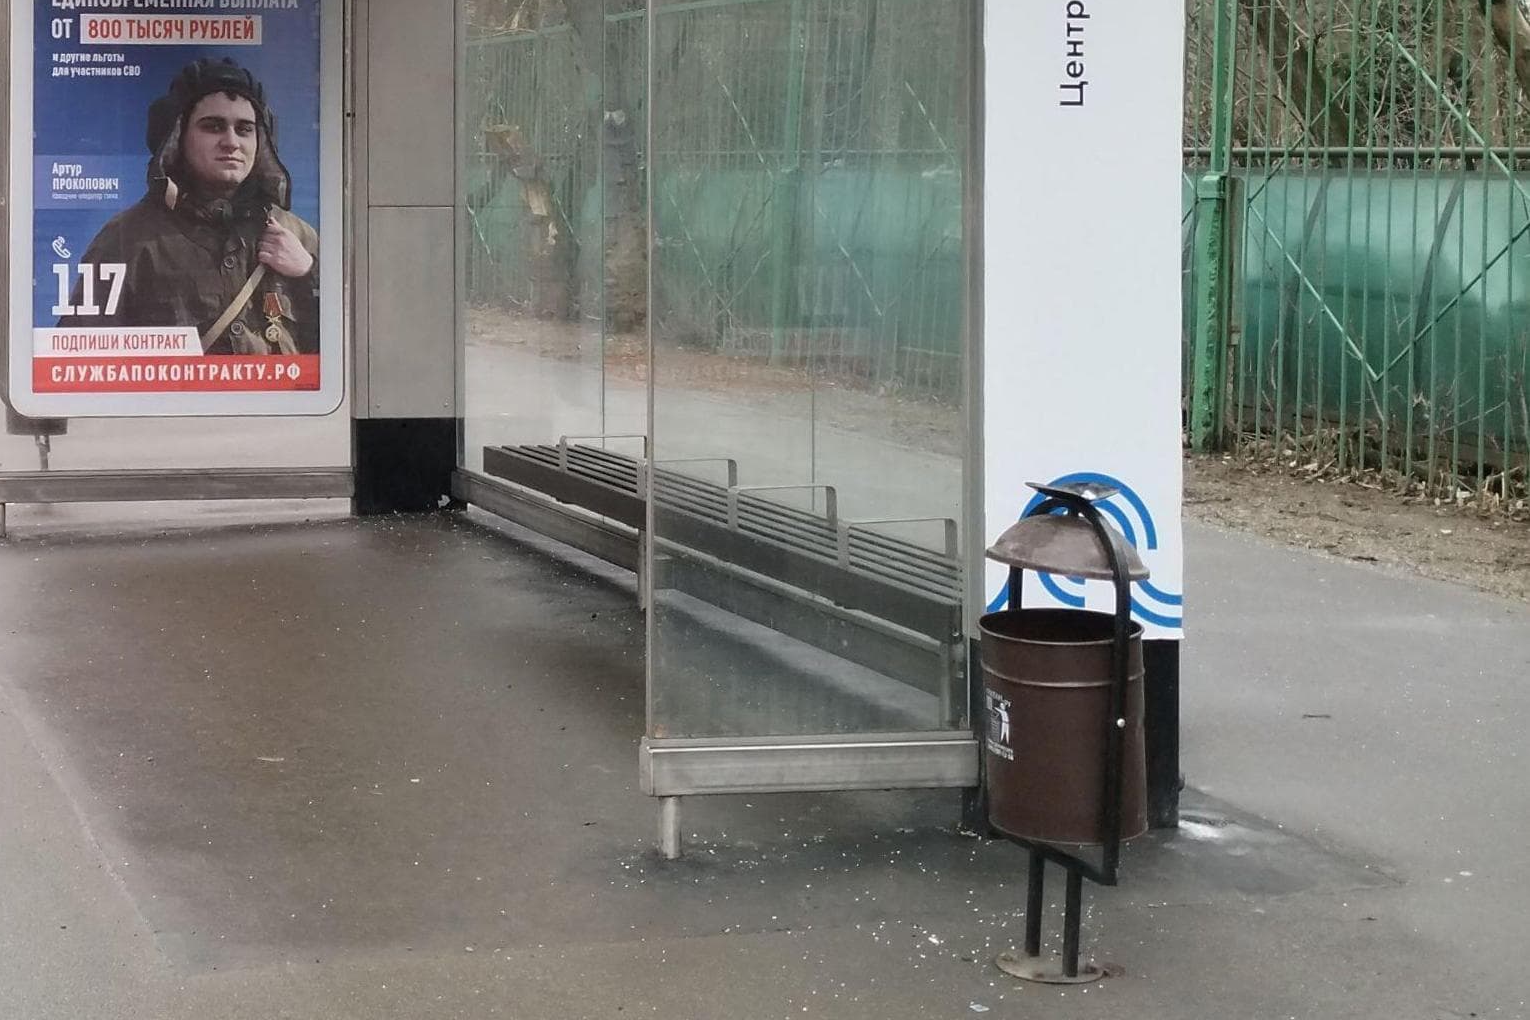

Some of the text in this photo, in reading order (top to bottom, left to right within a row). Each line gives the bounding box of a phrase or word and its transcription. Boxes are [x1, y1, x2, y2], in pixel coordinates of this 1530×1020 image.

[51, 15, 255, 40] ОТ 800 ТЫСЯЧ РУБЛЕЙ
[52, 53, 125, 64] и другие льготы
[1059, 0, 1091, 107] Центр
[52, 65, 141, 78] для участников СВО
[52, 162, 83, 177] Артур
[52, 177, 119, 190] ПРОКОПОВИЧ
[51, 263, 127, 317] 117
[51, 333, 188, 352] ПОДПИШИ КОНТРАКТ
[51, 362, 302, 382] СЛУЖБАПОКОНТРАКТУ.РФ
